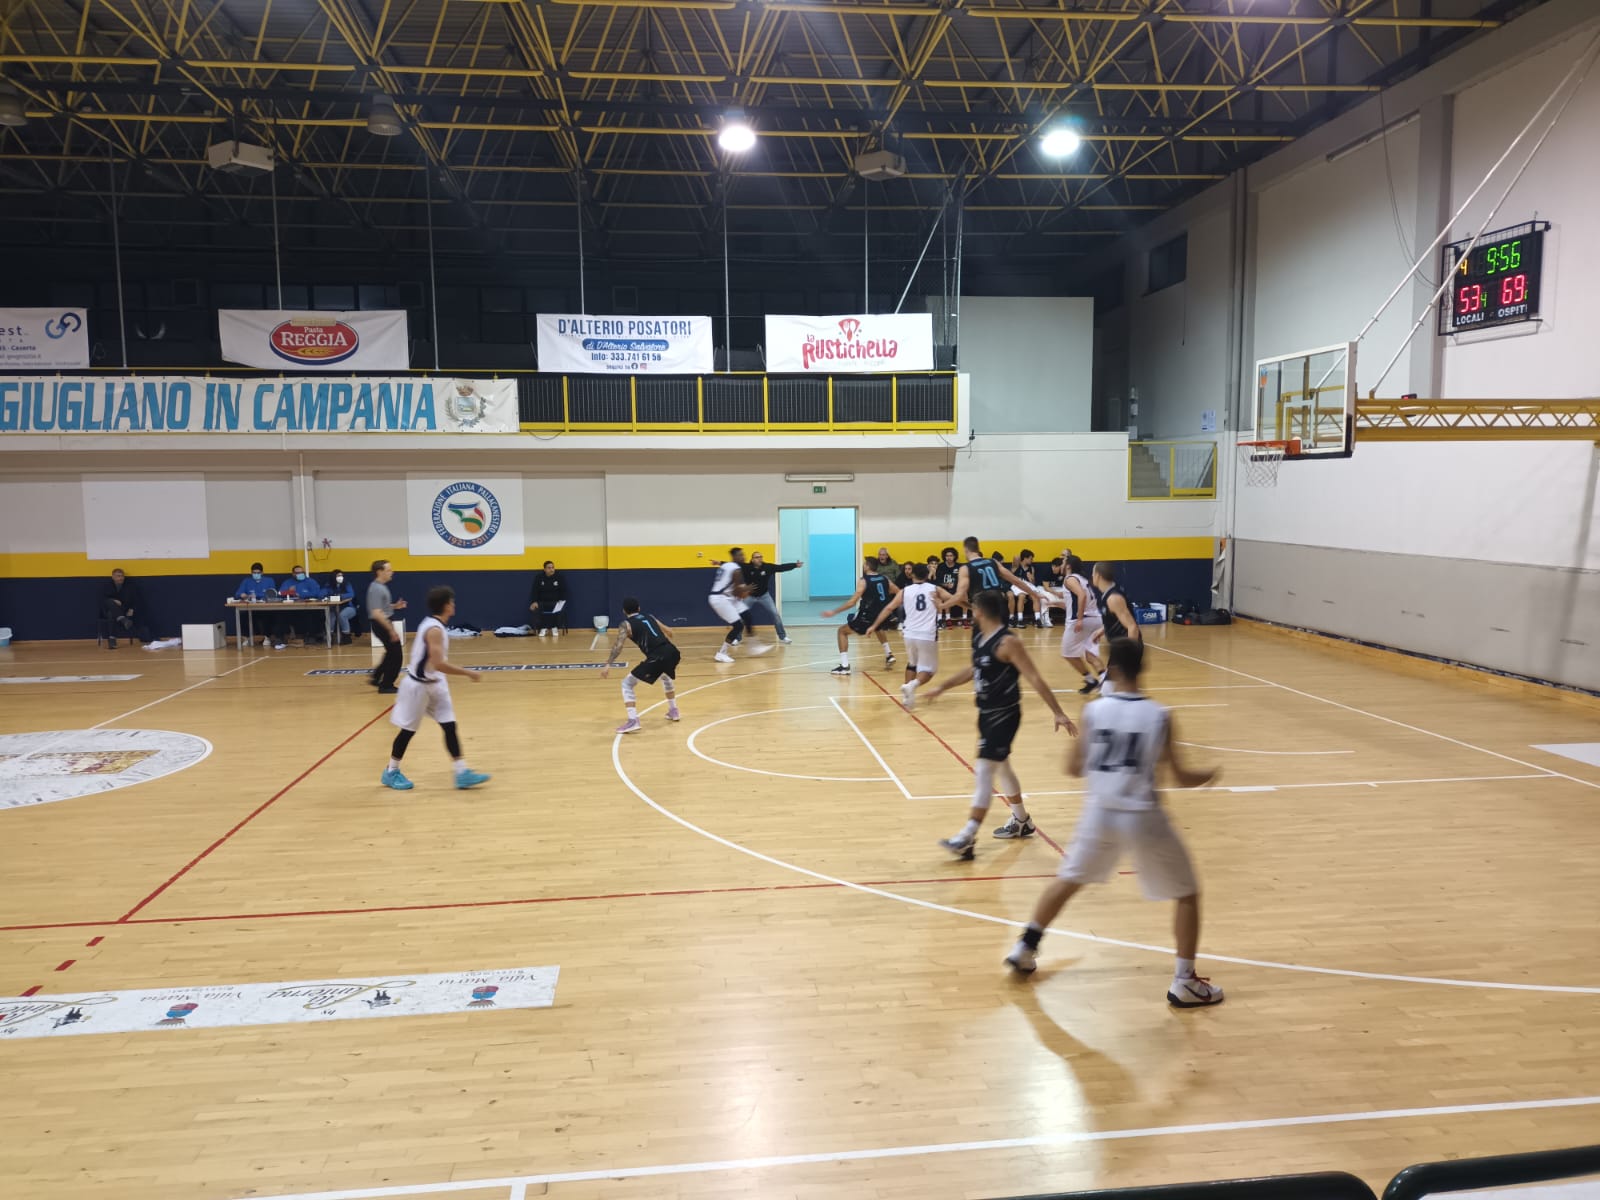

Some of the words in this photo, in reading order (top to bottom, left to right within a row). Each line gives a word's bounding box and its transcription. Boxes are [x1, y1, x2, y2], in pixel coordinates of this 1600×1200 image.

[1486, 240, 1521, 275] 9:56
[1459, 284, 1481, 313] 53
[1502, 274, 1525, 305] 69
[1456, 311, 1485, 326] LOCALI
[1497, 304, 1528, 318] OSPITI
[304, 326, 324, 334] Pasta
[558, 318, 624, 335] D'ALTERIO
[628, 320, 692, 336] POSATORI
[280, 331, 348, 346] REGGIA
[591, 352, 609, 361] Info:
[641, 352, 650, 361] 61
[0, 382, 191, 430] GIUGLIANO
[203, 383, 242, 430] IN
[253, 383, 437, 430] CAMPANIA
[432, 494, 447, 536] FEDERAZIONE
[446, 482, 475, 496] ITALIANA
[477, 486, 500, 534] PALLACANESTRO
[977, 566, 999, 589] 20
[876, 582, 886, 601] 9
[915, 593, 927, 611] 8
[438, 977, 488, 986] Maria
